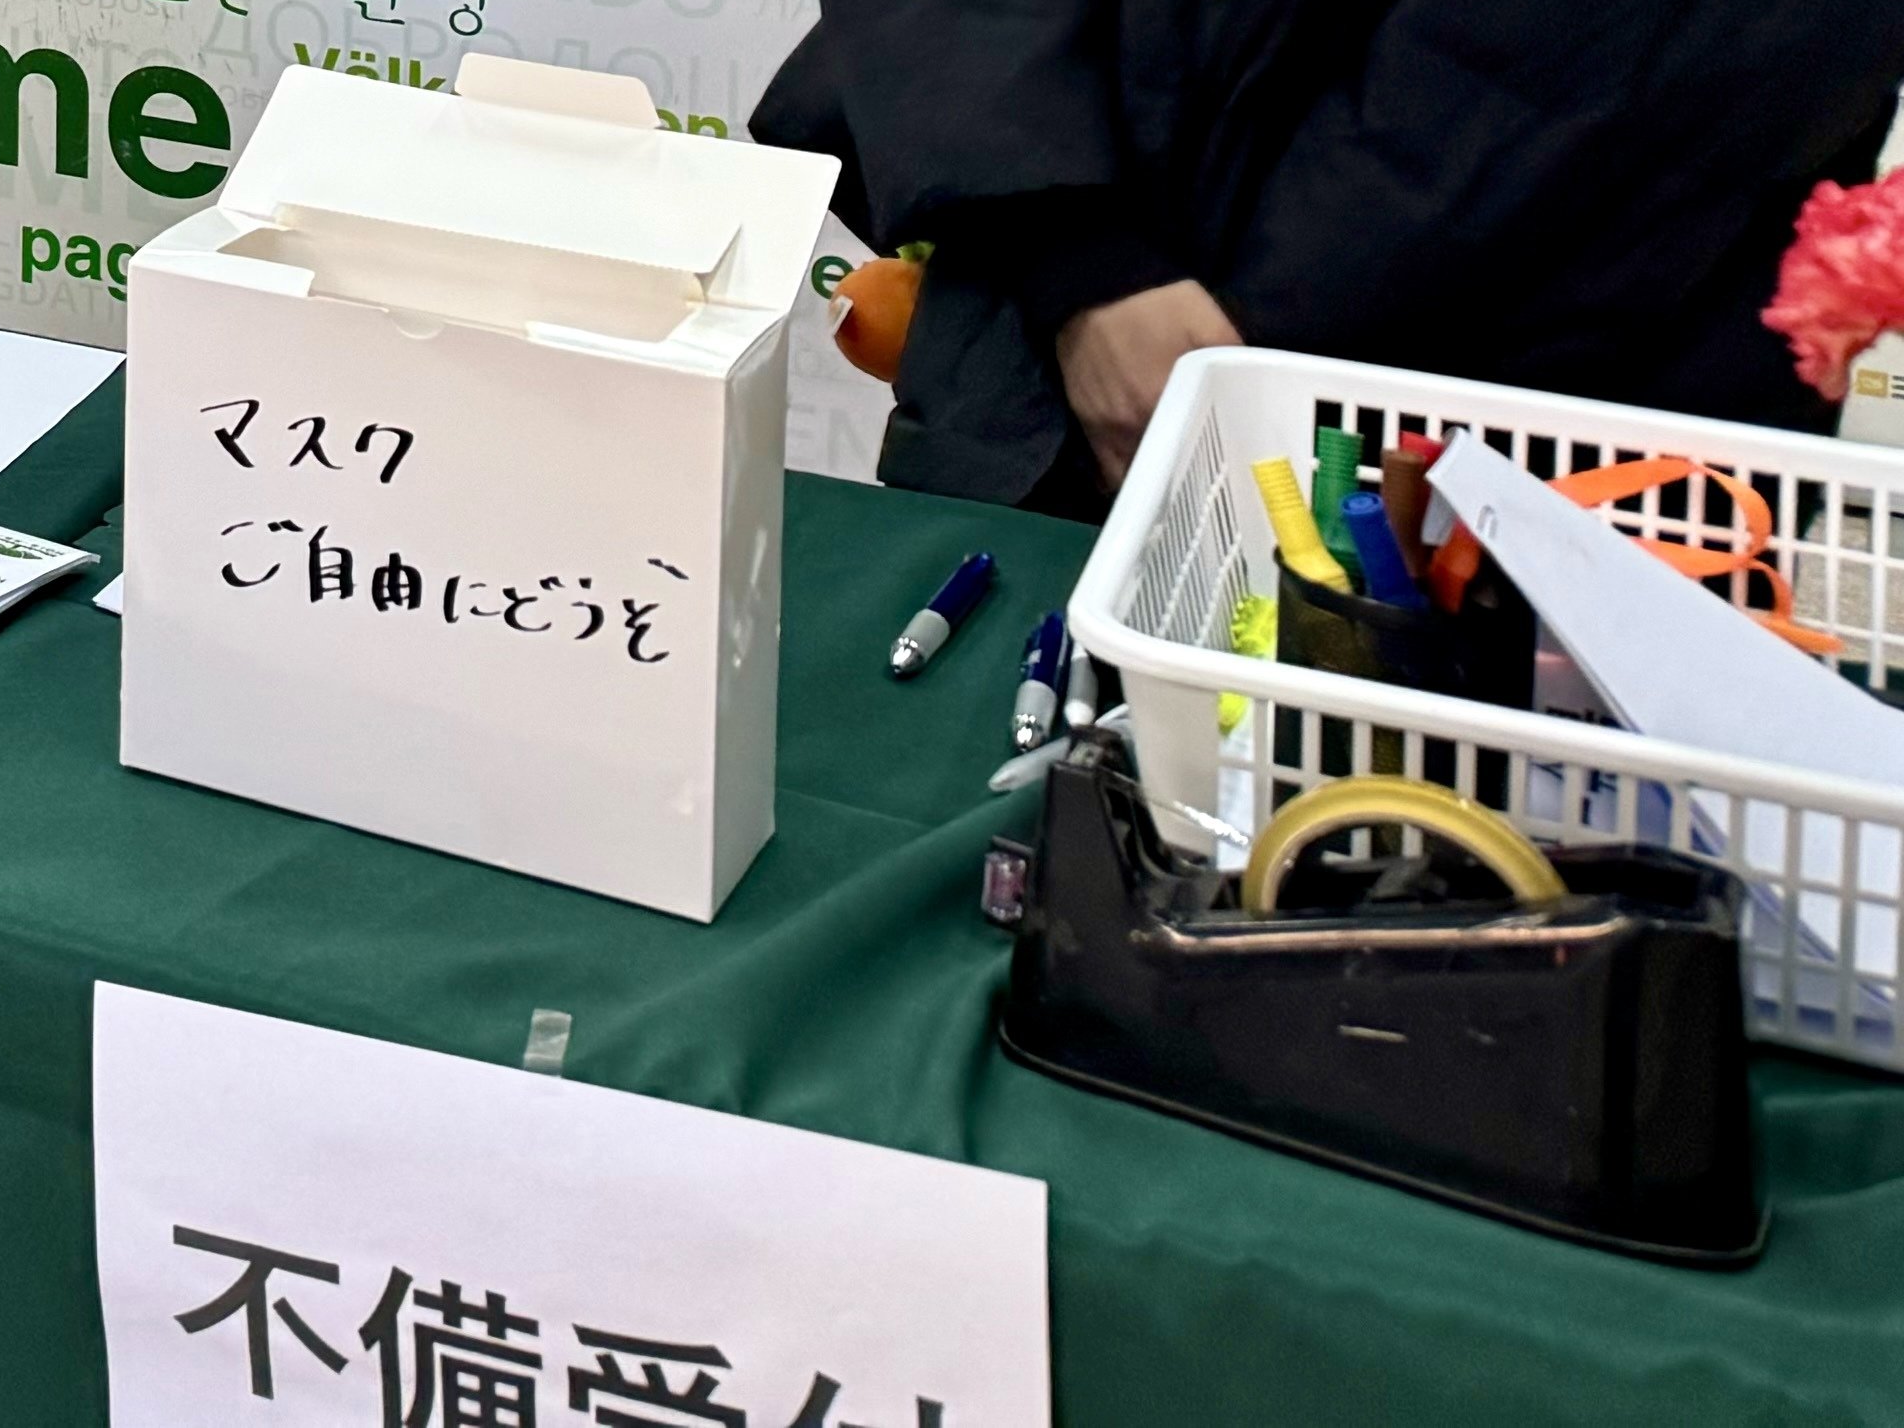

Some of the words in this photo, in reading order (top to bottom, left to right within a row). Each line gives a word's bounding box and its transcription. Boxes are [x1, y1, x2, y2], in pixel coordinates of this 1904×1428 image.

[199, 397, 415, 484] マスク
[220, 519, 690, 665] ご自由にどうぞ
